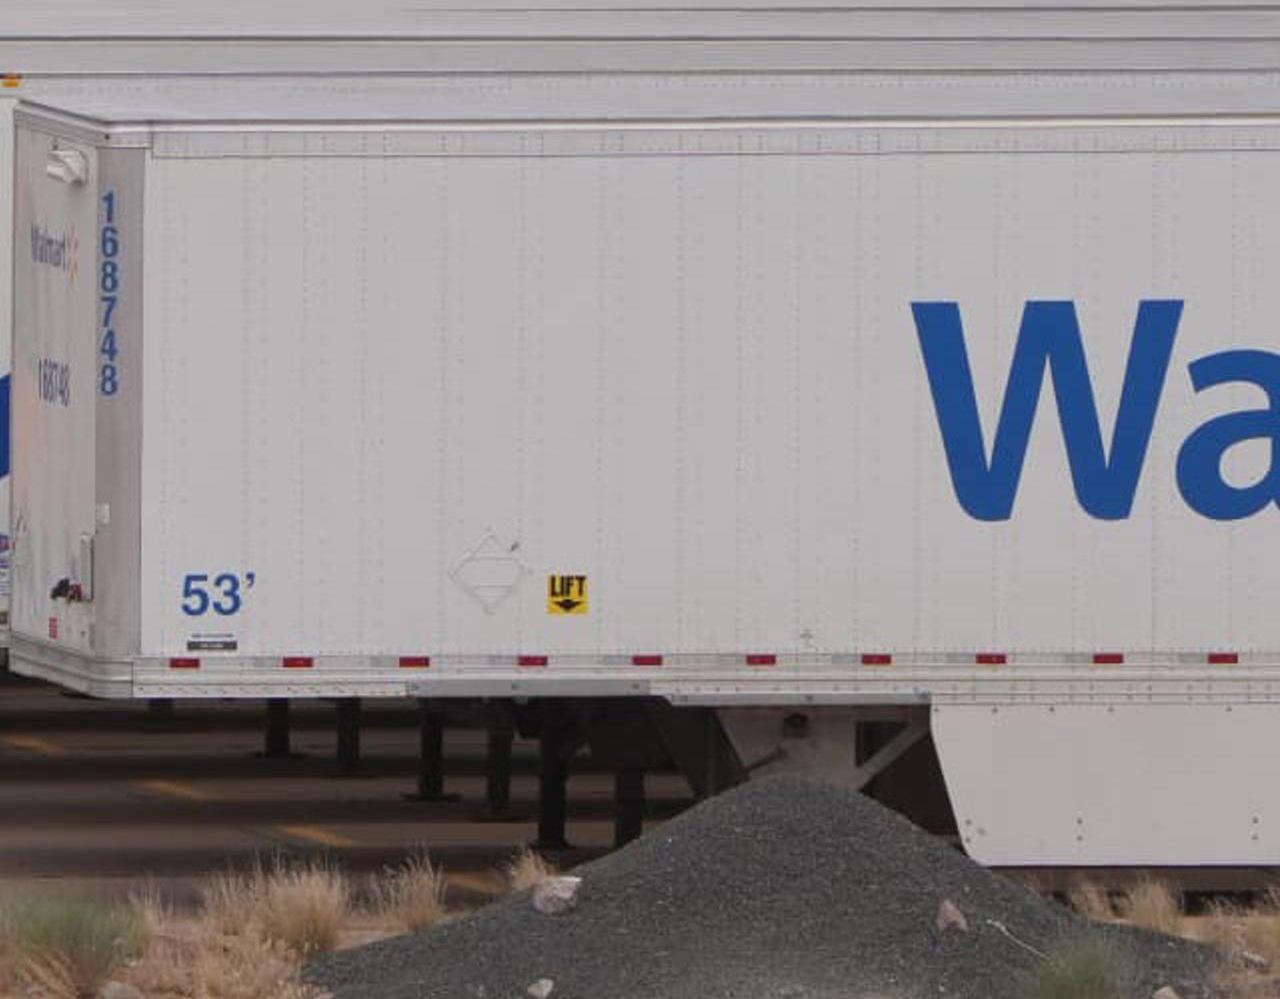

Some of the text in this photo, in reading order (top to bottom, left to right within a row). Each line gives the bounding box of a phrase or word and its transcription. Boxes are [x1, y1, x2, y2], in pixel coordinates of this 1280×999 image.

[30, 224, 66, 273] Walmart
[100, 190, 119, 396] 168748
[38, 357, 71, 409] 168748
[181, 572, 256, 616] 53'
[550, 574, 587, 598] LIFT
